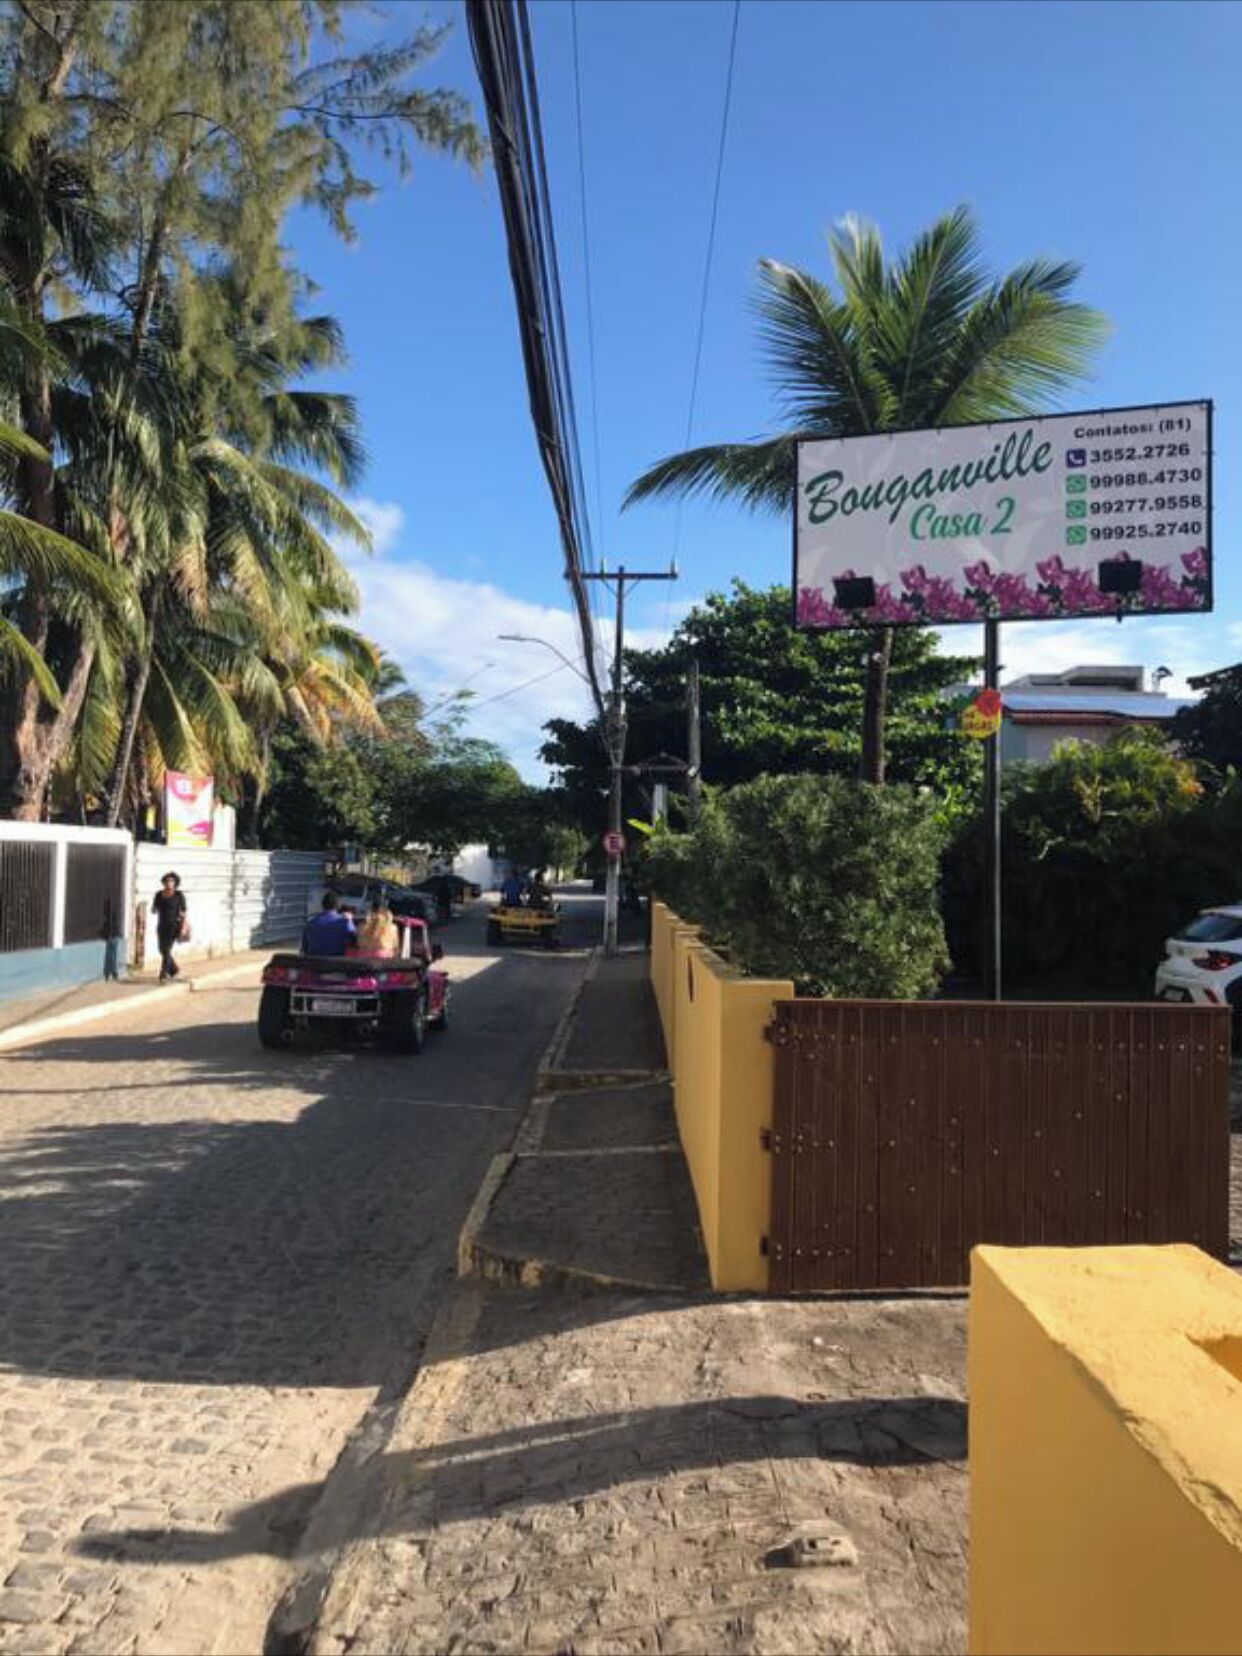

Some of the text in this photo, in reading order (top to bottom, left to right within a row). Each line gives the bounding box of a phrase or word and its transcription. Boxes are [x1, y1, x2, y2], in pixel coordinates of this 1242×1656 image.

[1074, 418, 1191, 439] Contatos: (81)
[1090, 443, 1190, 463] 3552.2726
[804, 428, 1053, 524] Bouganville
[1090, 467, 1202, 488] 99988.4730
[1090, 495, 1202, 515] 99277.9558
[911, 497, 1016, 540] Casa 2
[1090, 521, 1202, 541] 99925.2740
